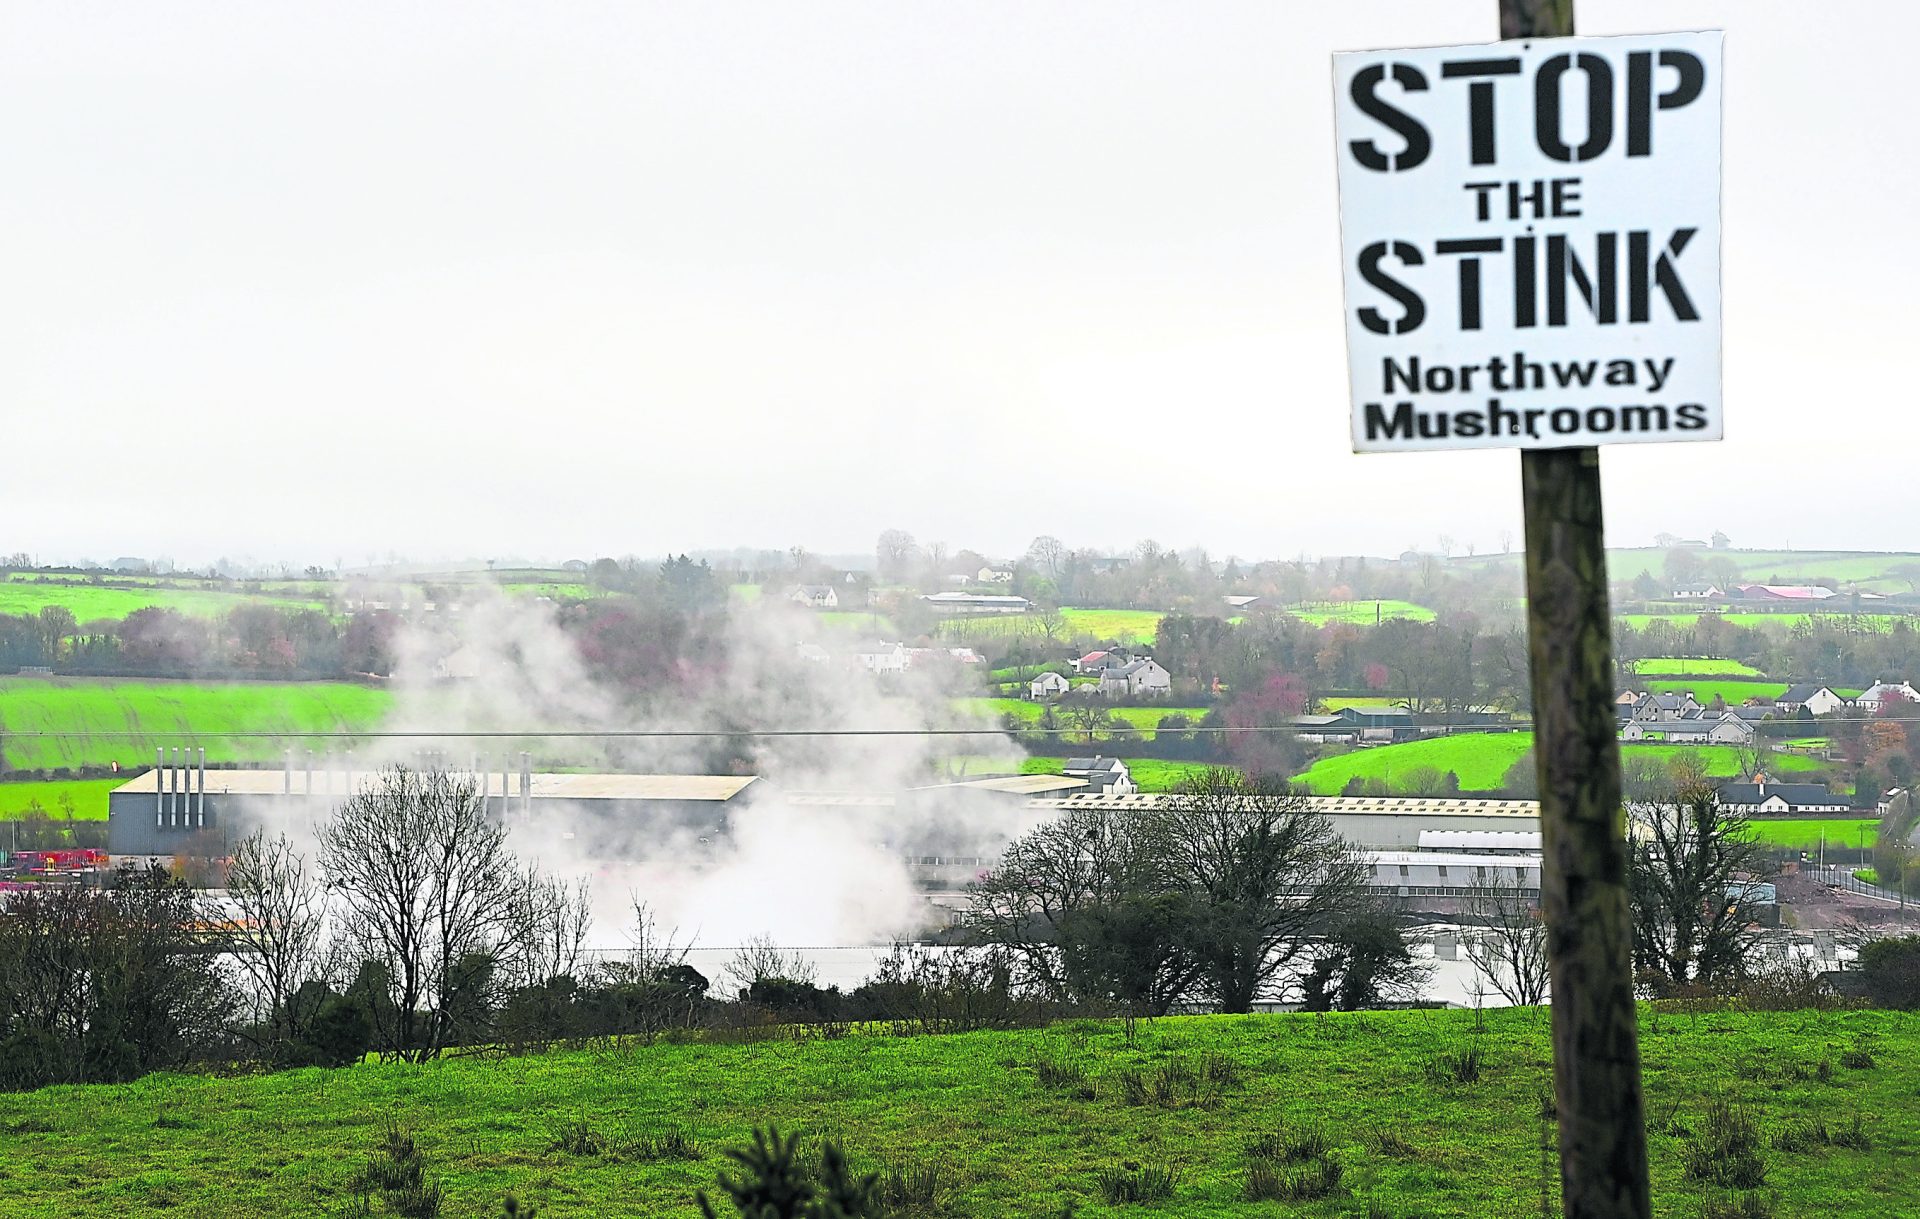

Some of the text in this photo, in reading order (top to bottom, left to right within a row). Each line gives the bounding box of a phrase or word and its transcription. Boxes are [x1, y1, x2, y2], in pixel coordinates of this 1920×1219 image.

[1349, 49, 1705, 173] STOP
[1463, 177, 1583, 222] THE
[1357, 227, 1701, 336] STINK
[1383, 352, 1675, 395] Northway
[1364, 398, 1709, 441] Mushrooms
